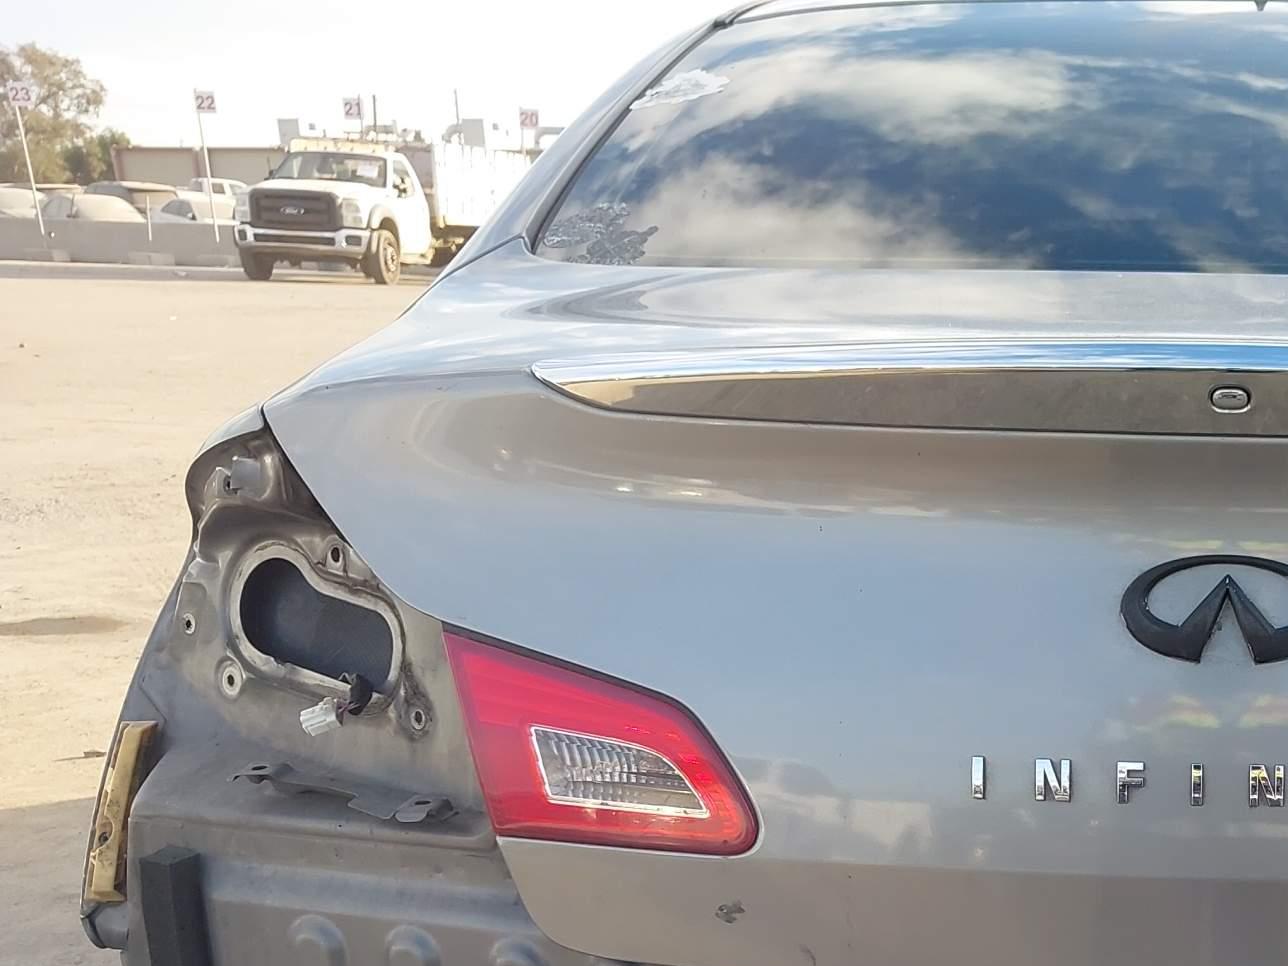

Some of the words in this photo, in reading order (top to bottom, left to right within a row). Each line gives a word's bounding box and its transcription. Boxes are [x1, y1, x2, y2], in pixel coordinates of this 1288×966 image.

[9, 86, 32, 102] 23
[195, 95, 216, 110] 22
[344, 102, 361, 116] 21
[519, 111, 539, 127] 20
